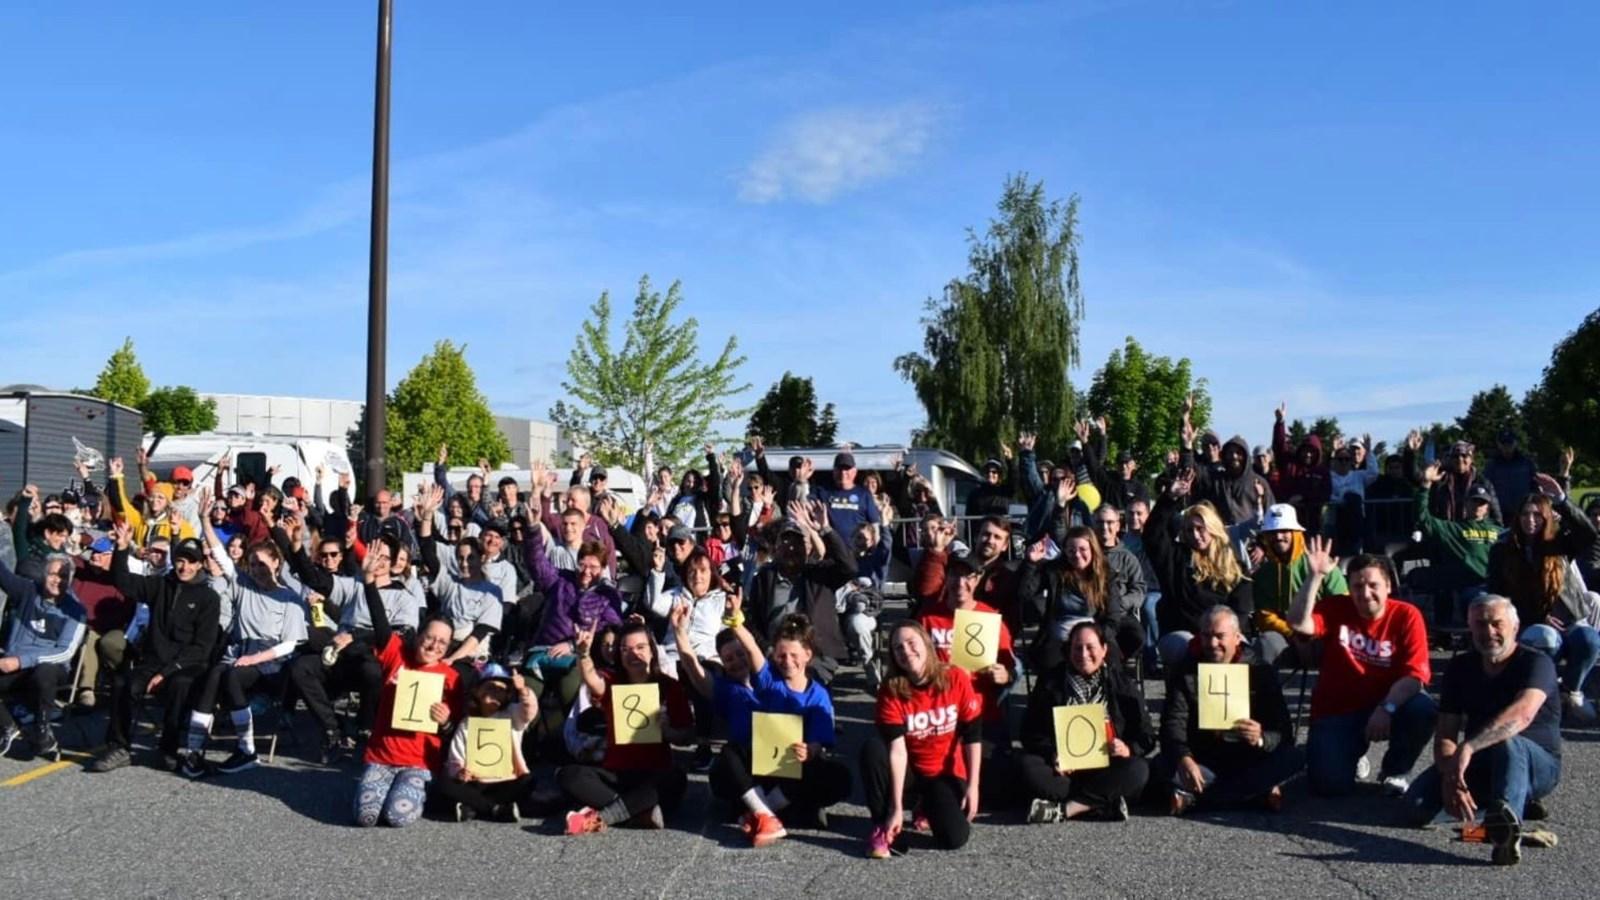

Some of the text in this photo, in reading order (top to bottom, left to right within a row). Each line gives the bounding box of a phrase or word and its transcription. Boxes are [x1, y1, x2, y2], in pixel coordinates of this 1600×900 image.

[965, 622, 985, 657] 8
[400, 680, 423, 723] 1
[621, 693, 650, 730] 8
[1207, 674, 1231, 721] 4
[475, 728, 504, 767] 5
[1065, 714, 1097, 758] 0
